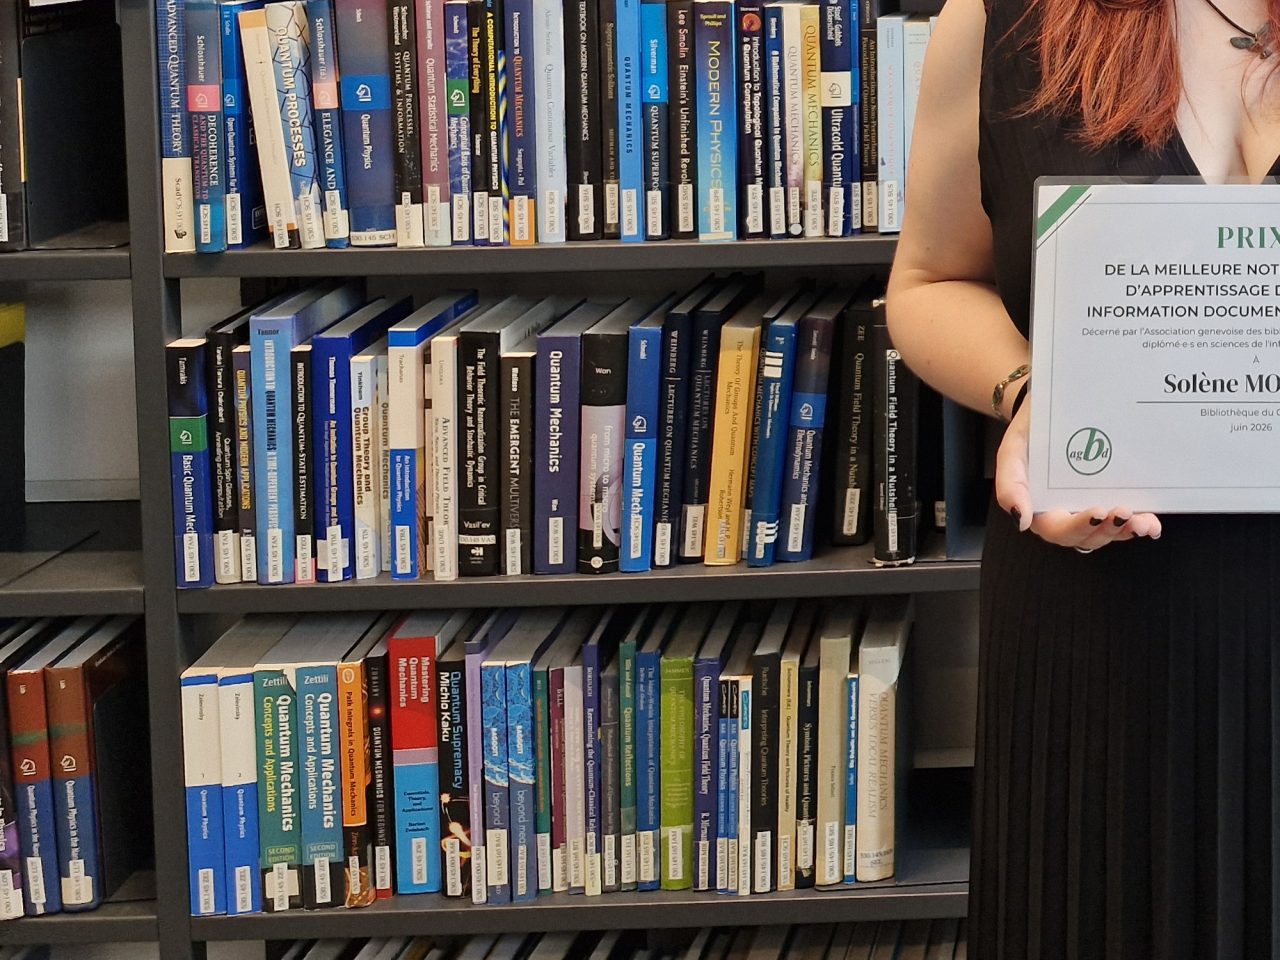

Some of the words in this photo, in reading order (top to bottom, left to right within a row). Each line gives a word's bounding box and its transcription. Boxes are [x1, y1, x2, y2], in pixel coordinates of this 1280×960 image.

[678, 10, 688, 25] Lee
[679, 29, 688, 58] Smolin
[168, 55, 180, 108] QUANTUM
[274, 27, 295, 88] QUANTUM
[286, 93, 306, 167] PROCESSES
[679, 64, 690, 104] Einstein's
[708, 40, 721, 115] MODERN
[171, 113, 182, 153] THEORY
[208, 115, 218, 186] DECOHERENCE
[680, 107, 690, 154] Unfinished
[710, 120, 722, 188] PHYSICS
[1105, 264, 1126, 275] DE
[1131, 264, 1150, 275] LA
[1155, 264, 1242, 275] MEILLEURE
[1126, 284, 1270, 296] D'APPRENTISSAGE
[1087, 305, 1198, 318] INFORMATION
[549, 351, 562, 403] Quantum
[1164, 372, 1239, 394] Solène
[1201, 408, 1259, 419] Bibliothèque
[1262, 408, 1274, 417] du
[1230, 423, 1249, 434] juin
[1251, 423, 1273, 432] 2026
[510, 419, 520, 475] EMERGENT
[549, 408, 562, 472] Mechanics
[398, 658, 407, 707] Mechanics
[409, 657, 419, 699] Quantum
[421, 657, 430, 702] Mastering
[441, 672, 449, 713] Michio
[451, 671, 462, 729] Quantum
[263, 696, 274, 737] Concepts
[277, 695, 293, 757] Quantum
[441, 716, 450, 741] Kaku
[265, 740, 274, 755] and
[451, 733, 463, 788] Supremacy
[265, 758, 276, 812] Applications
[280, 760, 294, 831] Mechanics
